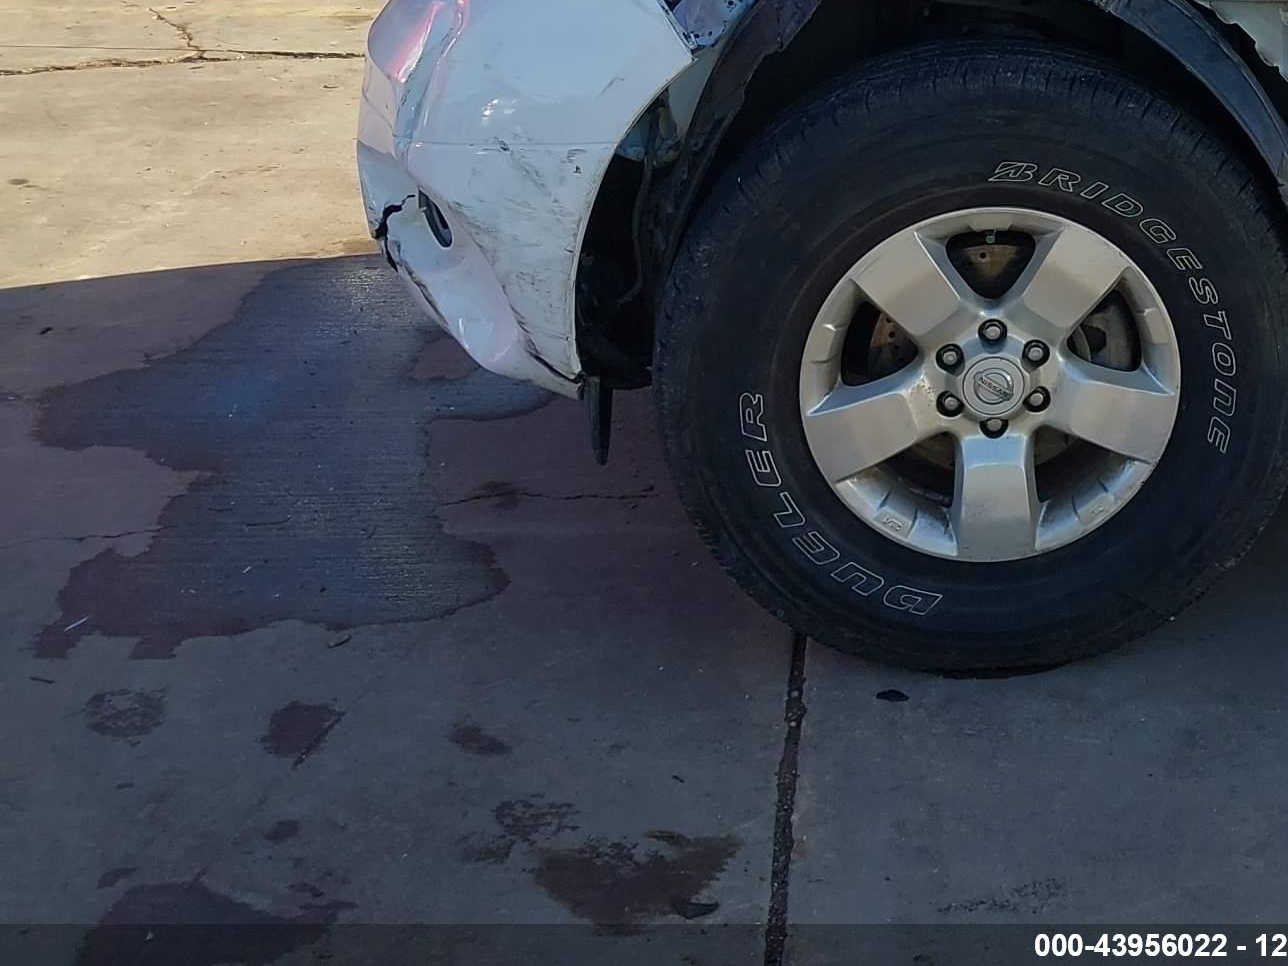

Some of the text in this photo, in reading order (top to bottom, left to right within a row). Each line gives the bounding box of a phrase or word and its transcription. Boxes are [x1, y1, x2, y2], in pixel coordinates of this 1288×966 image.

[979, 377, 1011, 398] NISSAN
[988, 162, 1236, 454] BRIDGESTONE
[739, 392, 943, 615] DUELER
